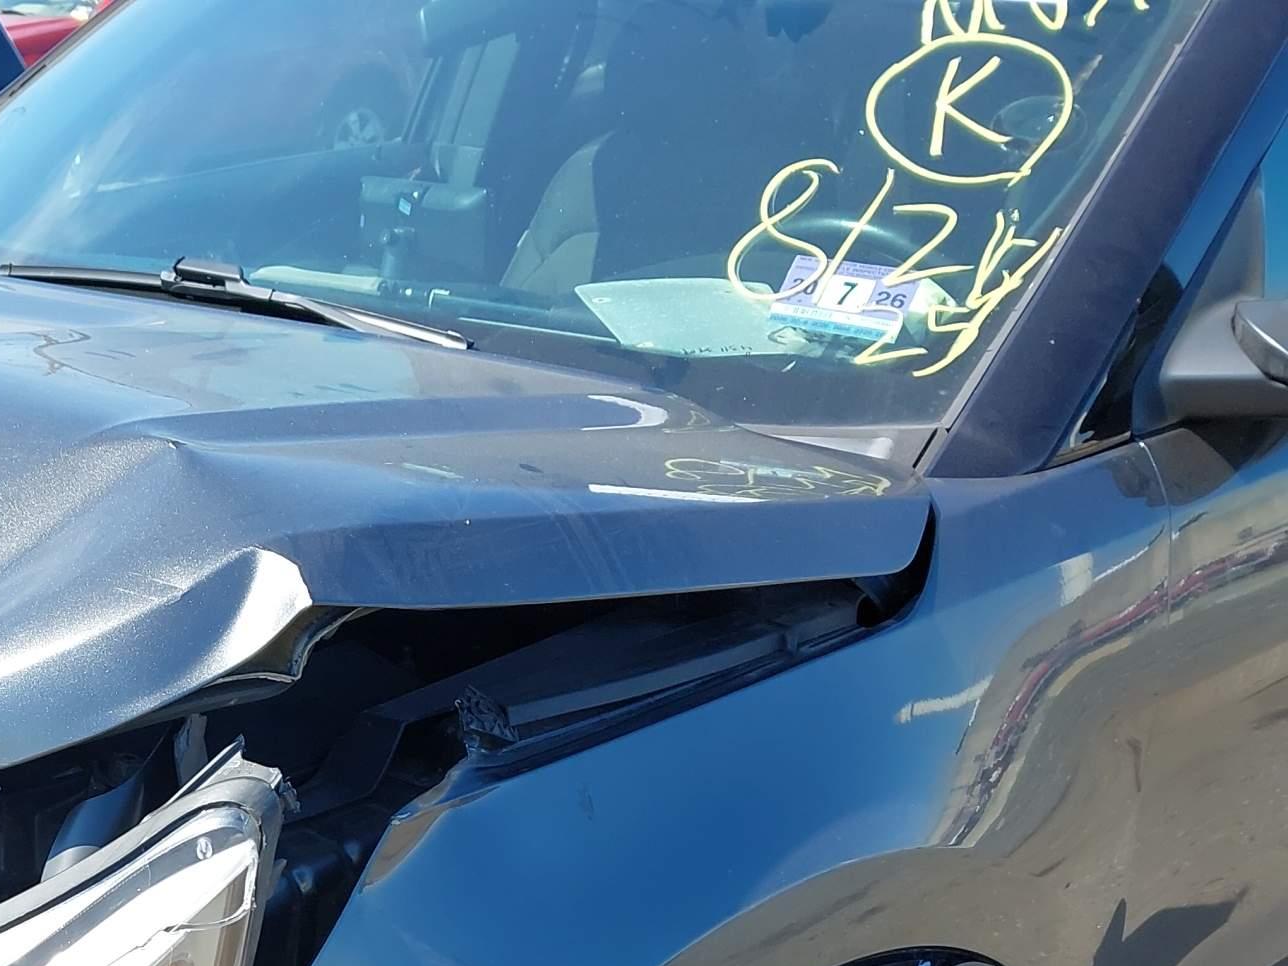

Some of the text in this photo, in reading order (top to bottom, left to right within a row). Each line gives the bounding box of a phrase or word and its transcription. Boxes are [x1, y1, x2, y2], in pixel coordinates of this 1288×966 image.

[929, 55, 1011, 156] K
[837, 281, 858, 305] 7
[875, 290, 907, 309] 26
